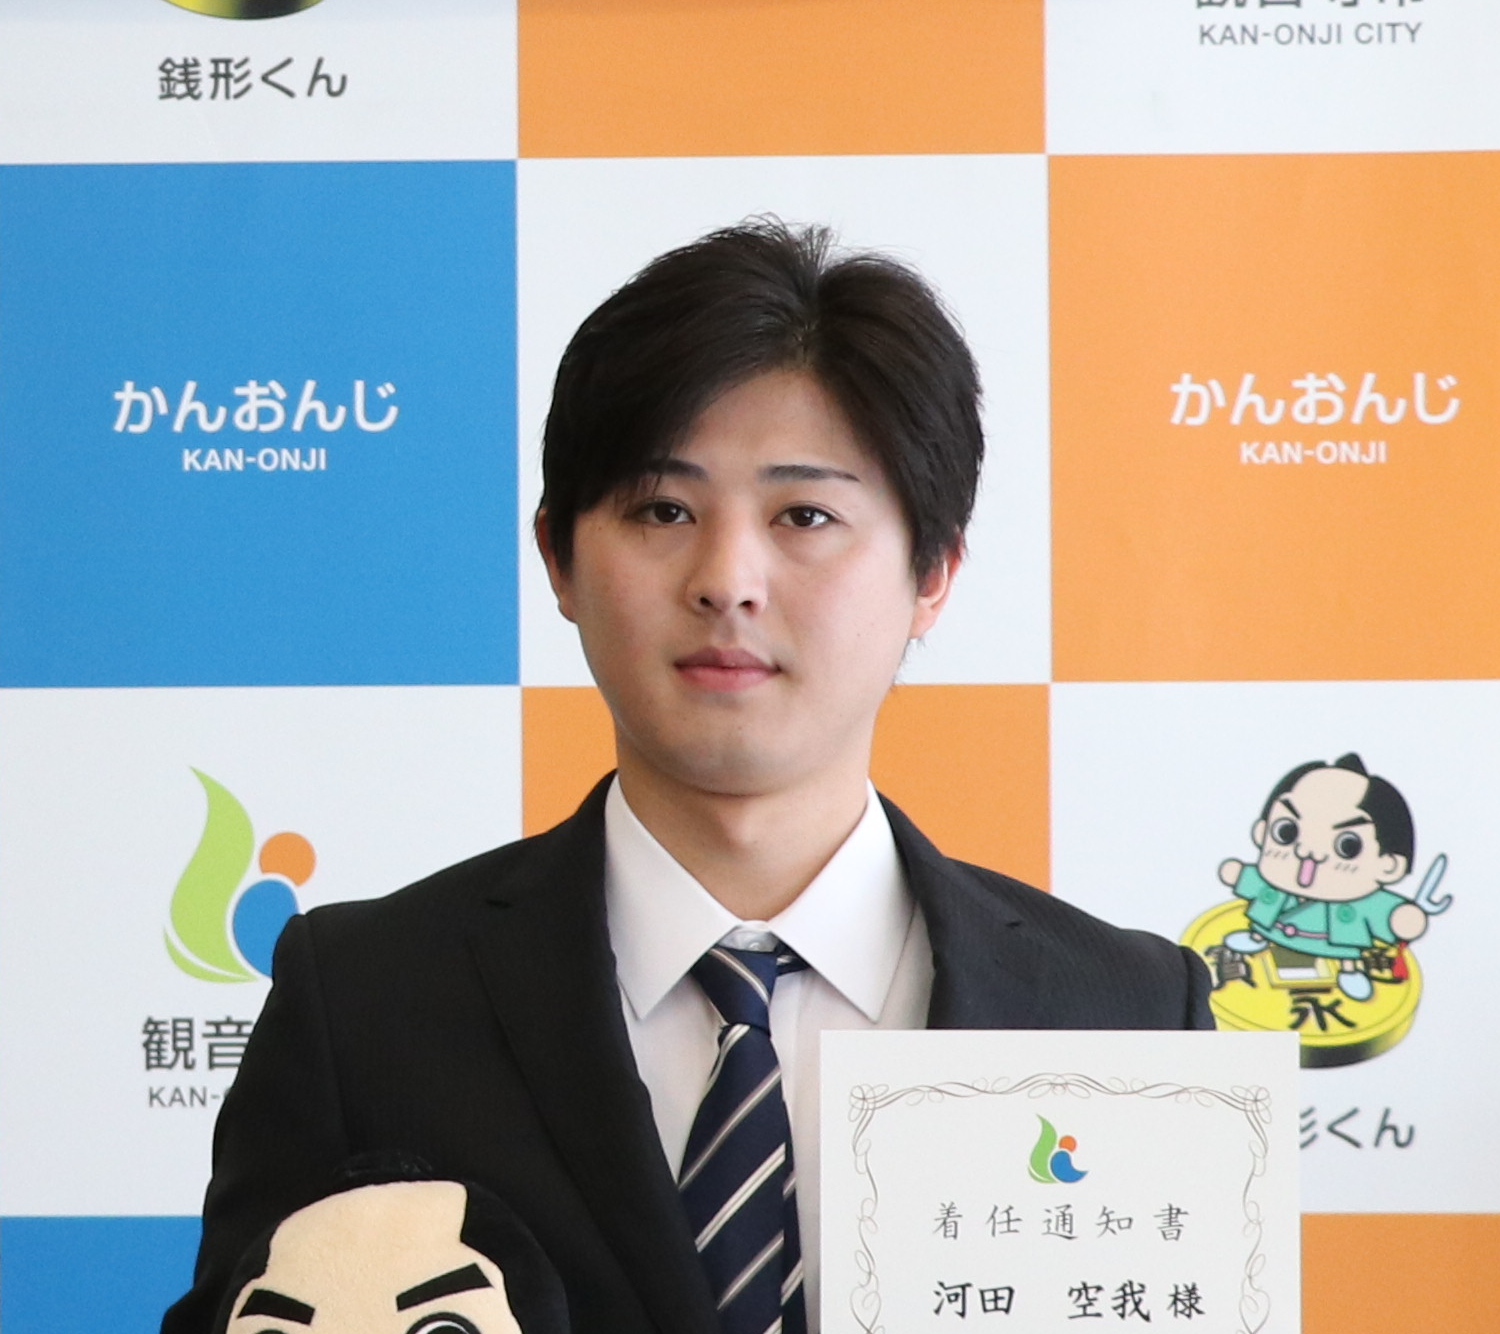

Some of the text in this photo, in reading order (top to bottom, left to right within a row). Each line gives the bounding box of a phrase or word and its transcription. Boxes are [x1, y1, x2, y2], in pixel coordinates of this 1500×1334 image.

[1200, 23, 1421, 45] KAN-ONJI CITY
[158, 57, 347, 100] 銭形くん
[113, 379, 399, 434] かんおんじ
[1169, 372, 1460, 427] かんおんじ
[182, 448, 326, 471] KAN-ONJI
[1239, 440, 1387, 465] KAN-ONJI
[142, 1016, 254, 1071] 観音
[1299, 1106, 1415, 1149] くん
[935, 1202, 1188, 1240] 着任通知書
[934, 1280, 1204, 1322] 河田 空我 様
